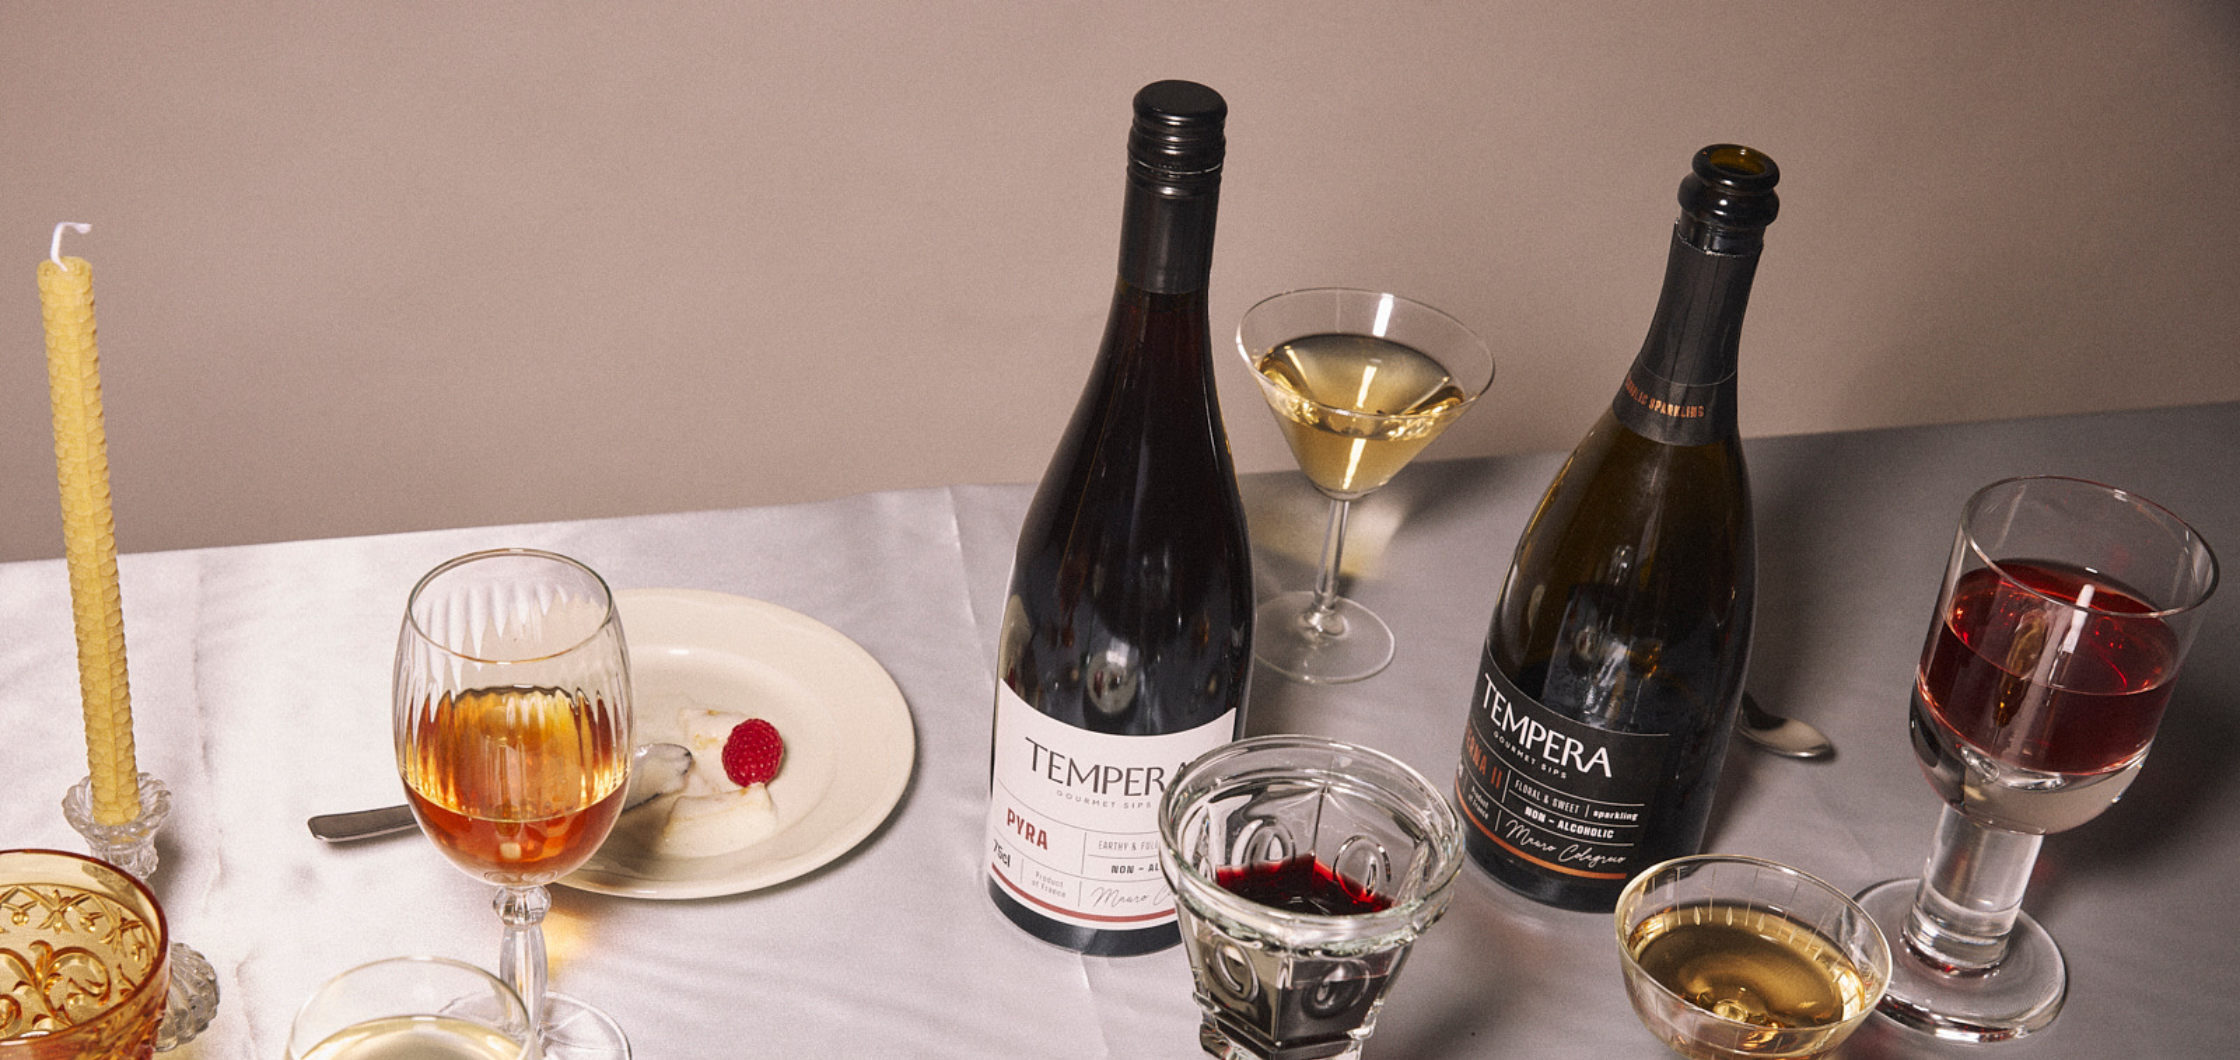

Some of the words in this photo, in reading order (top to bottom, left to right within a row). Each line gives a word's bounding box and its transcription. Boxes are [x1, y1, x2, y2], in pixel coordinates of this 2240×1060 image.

[1648, 397, 1705, 419] SPARKLING
[1482, 672, 1613, 779] TEMPERA
[1025, 736, 1187, 797] TEMPER
[1493, 730, 1537, 766] GOURMET
[1540, 763, 1568, 779] SIPS
[1056, 789, 1117, 808] GOURMET
[1123, 801, 1152, 810] SIPS
[1514, 779, 1542, 801] FLORAL
[1543, 795, 1549, 805] &
[1552, 797, 1581, 814] SWEET
[1007, 807, 1048, 850] PYRA
[1524, 806, 1547, 824] NON
[1557, 819, 1615, 840] ALCOHOLIC
[1592, 809, 1639, 822] sparkling
[992, 838, 1012, 868] 75cl
[1098, 840, 1128, 851] EARTHY
[1131, 841, 1137, 851] &
[1035, 870, 1064, 888] Product
[1111, 864, 1135, 874] NON
[1031, 879, 1039, 887] of
[1040, 881, 1067, 898] France
